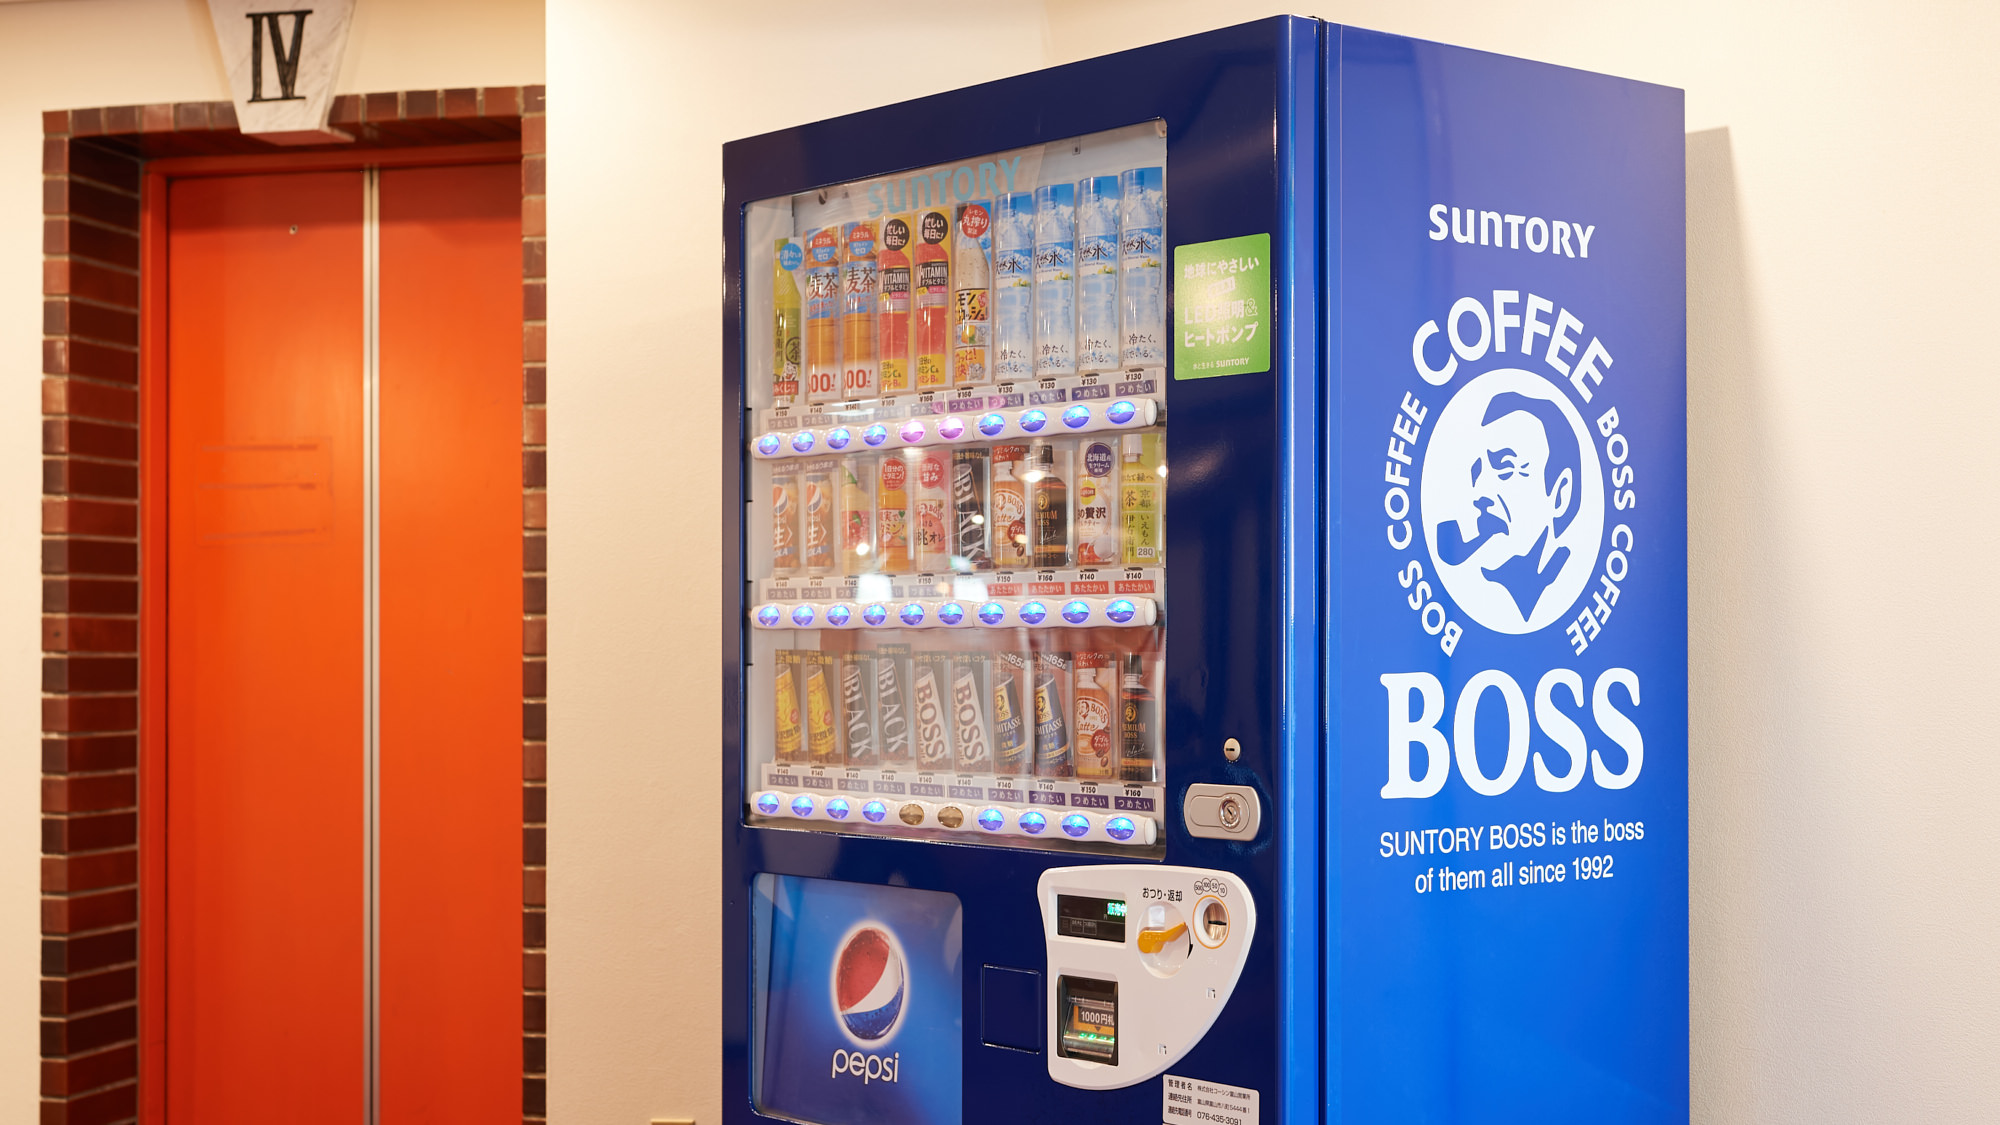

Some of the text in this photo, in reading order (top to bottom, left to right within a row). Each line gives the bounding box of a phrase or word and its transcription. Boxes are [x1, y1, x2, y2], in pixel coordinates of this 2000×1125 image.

[246, 9, 313, 103] IV
[868, 157, 1021, 218] SUNTORY
[924, 217, 943, 229] 忙しい
[962, 216, 988, 229] 丸搾り
[886, 225, 905, 235] 忙しい
[1428, 203, 1595, 258] SUNTORY
[1184, 257, 1260, 279] 地球にやさしい
[809, 272, 839, 300] 麦茶
[847, 267, 876, 295] 麦茶
[1184, 321, 1259, 348] ヒートポンプ
[1412, 290, 1614, 404] COFFEE
[1216, 357, 1250, 368] SUNTORY
[1081, 378, 1097, 386] ¥130
[1125, 373, 1142, 381] ¥130
[1074, 387, 1106, 399] つめたい
[1118, 382, 1152, 394] つめたい
[991, 394, 1021, 406] つめたい
[1032, 391, 1064, 402] つめたい
[951, 399, 981, 411] つめたい
[884, 464, 903, 472] 1日分の
[923, 473, 939, 482] 甘み
[1006, 494, 1024, 514] BOSS
[1125, 490, 1137, 507] 茶
[954, 474, 986, 562] BLACK
[1141, 514, 1150, 546] いえもん
[1384, 391, 1464, 658] BOSS COFFEE
[1565, 406, 1636, 657] BOSS COFFEE
[1138, 548, 1153, 556] 280
[1038, 574, 1053, 582] ¥160
[803, 589, 829, 598] つめたい
[990, 584, 1020, 596] あたたかい
[1031, 583, 1063, 595] あたたかい
[1074, 583, 1106, 594] あたたかい
[1118, 582, 1151, 593] あたたかい
[879, 668, 907, 753] BLACK
[1090, 704, 1108, 724] BOSS
[844, 679, 872, 758] BLACK
[918, 680, 945, 758] BOSS
[956, 681, 984, 760] BOSS
[1380, 667, 1644, 799] BOSS
[771, 776, 797, 785] つめたい
[805, 778, 831, 788] つめたい
[839, 780, 867, 790] つめたい
[875, 782, 904, 793] つめたい
[913, 785, 941, 796] つめたい
[951, 787, 981, 799] つめたい
[1081, 786, 1097, 794] ¥150
[1125, 789, 1141, 797] ¥160
[991, 790, 1022, 801] つめたい
[1033, 793, 1063, 804] つめたい
[1074, 796, 1106, 807] つめたい
[1117, 798, 1151, 810] つめたい
[1380, 817, 1644, 858] SUNTORY BOSS is the boss
[1415, 854, 1614, 894] of them all since 1992
[1142, 887, 1183, 902] おつり・返却
[831, 1048, 899, 1086] pepsi
[1168, 1079, 1192, 1091] 管理者名
[1197, 1111, 1242, 1125] 076-435-3091
